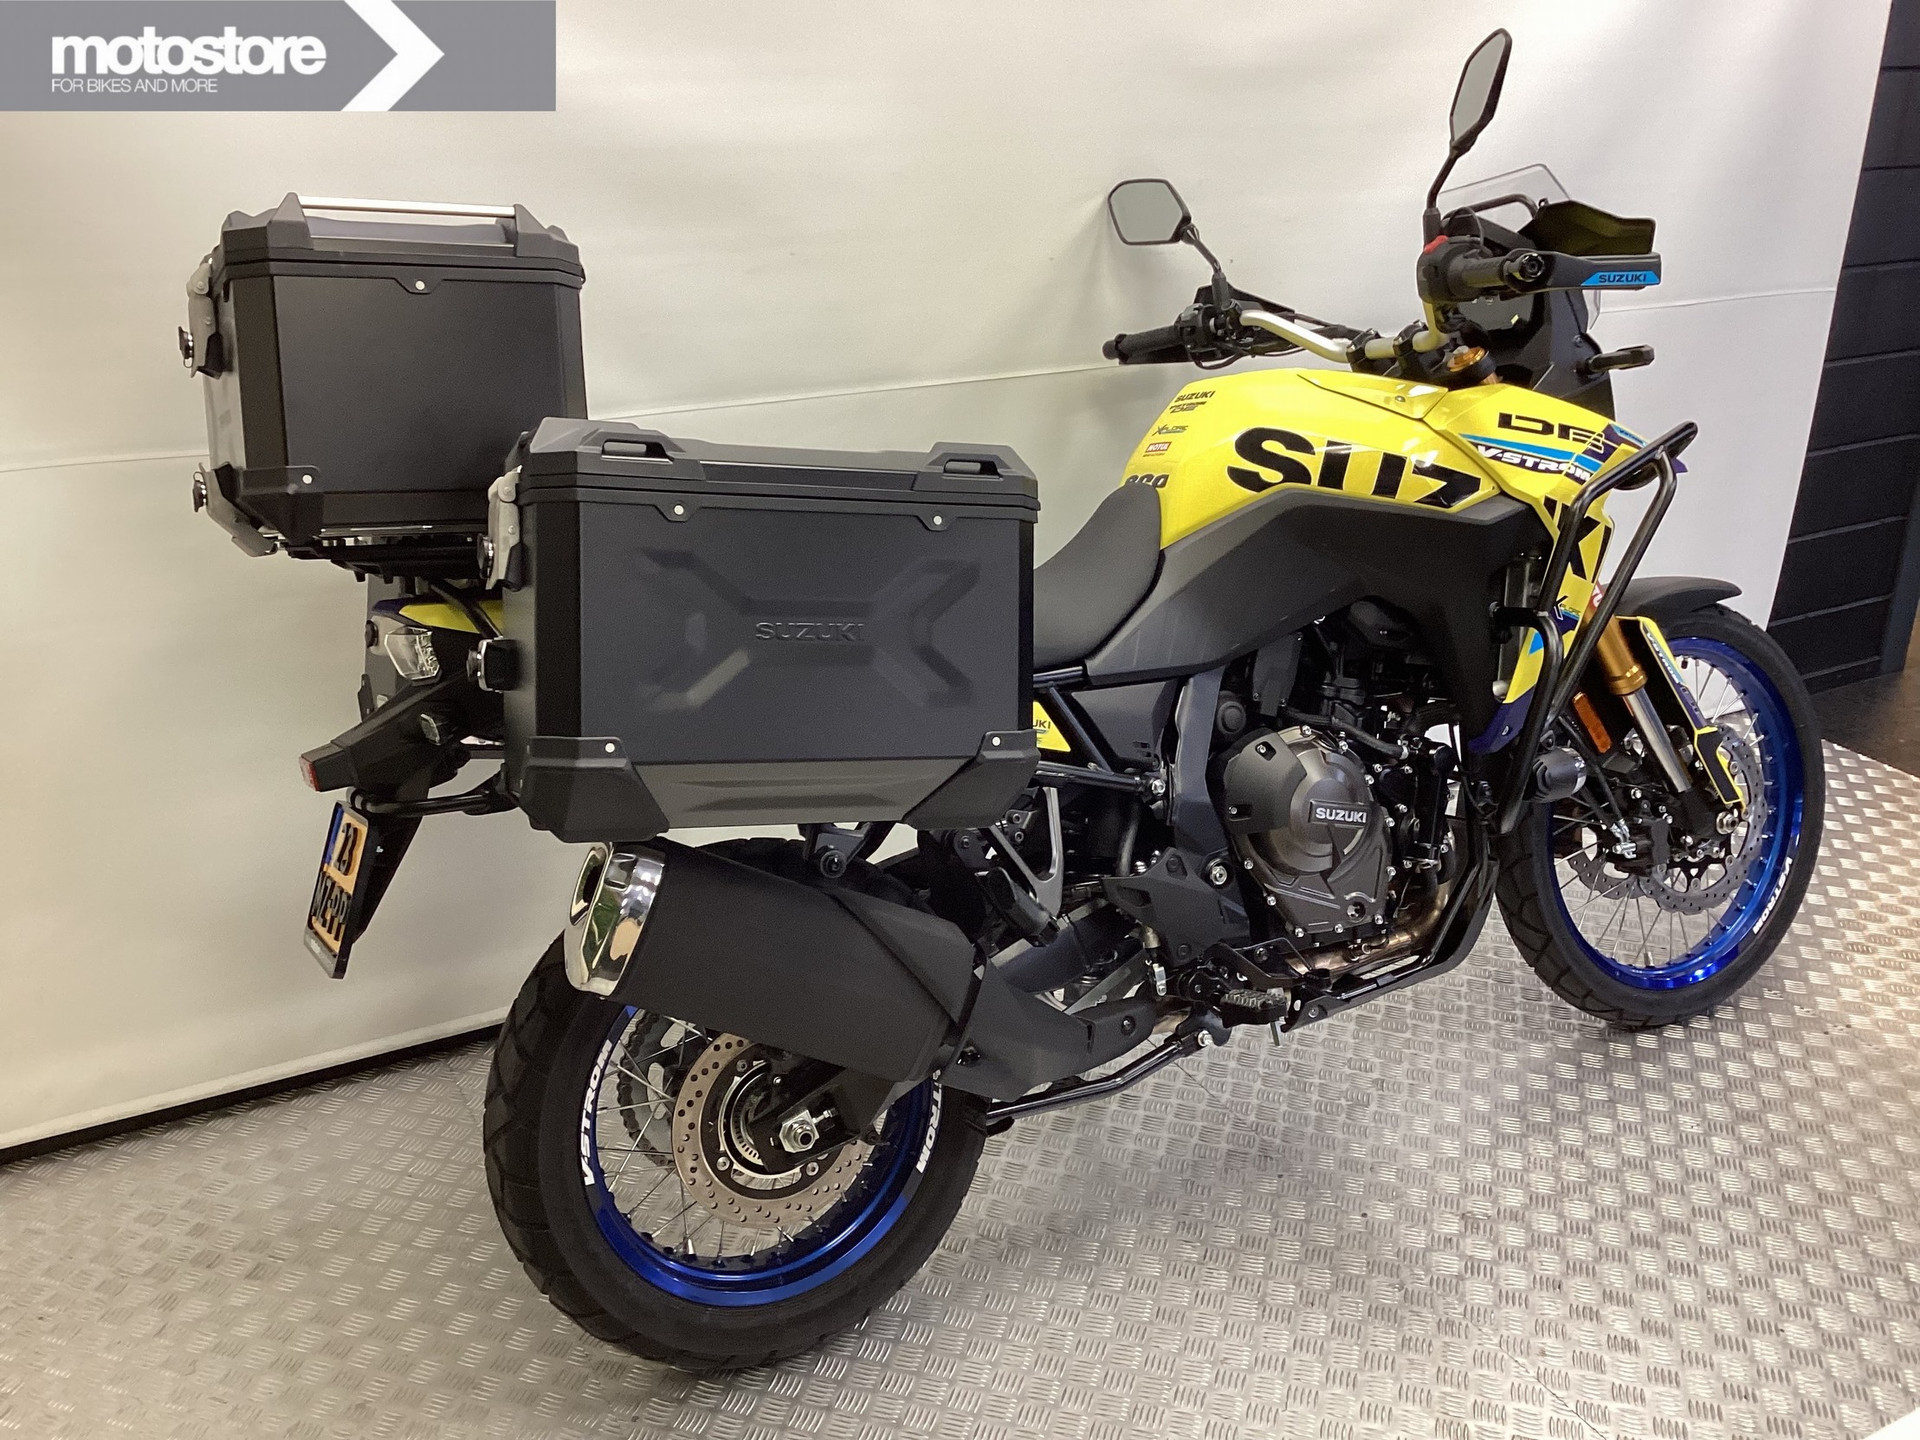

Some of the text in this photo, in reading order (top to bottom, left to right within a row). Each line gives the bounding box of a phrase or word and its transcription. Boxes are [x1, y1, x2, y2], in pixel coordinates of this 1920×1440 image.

[1598, 274, 1647, 283] SUZUKI
[1175, 391, 1216, 403] SUZUKI
[1147, 442, 1169, 452] MOTUL
[1477, 445, 1594, 482] V-STROM
[755, 622, 865, 641] SUZUKI
[1315, 807, 1367, 823] SUZUKI
[580, 1039, 613, 1186] V-STROM
